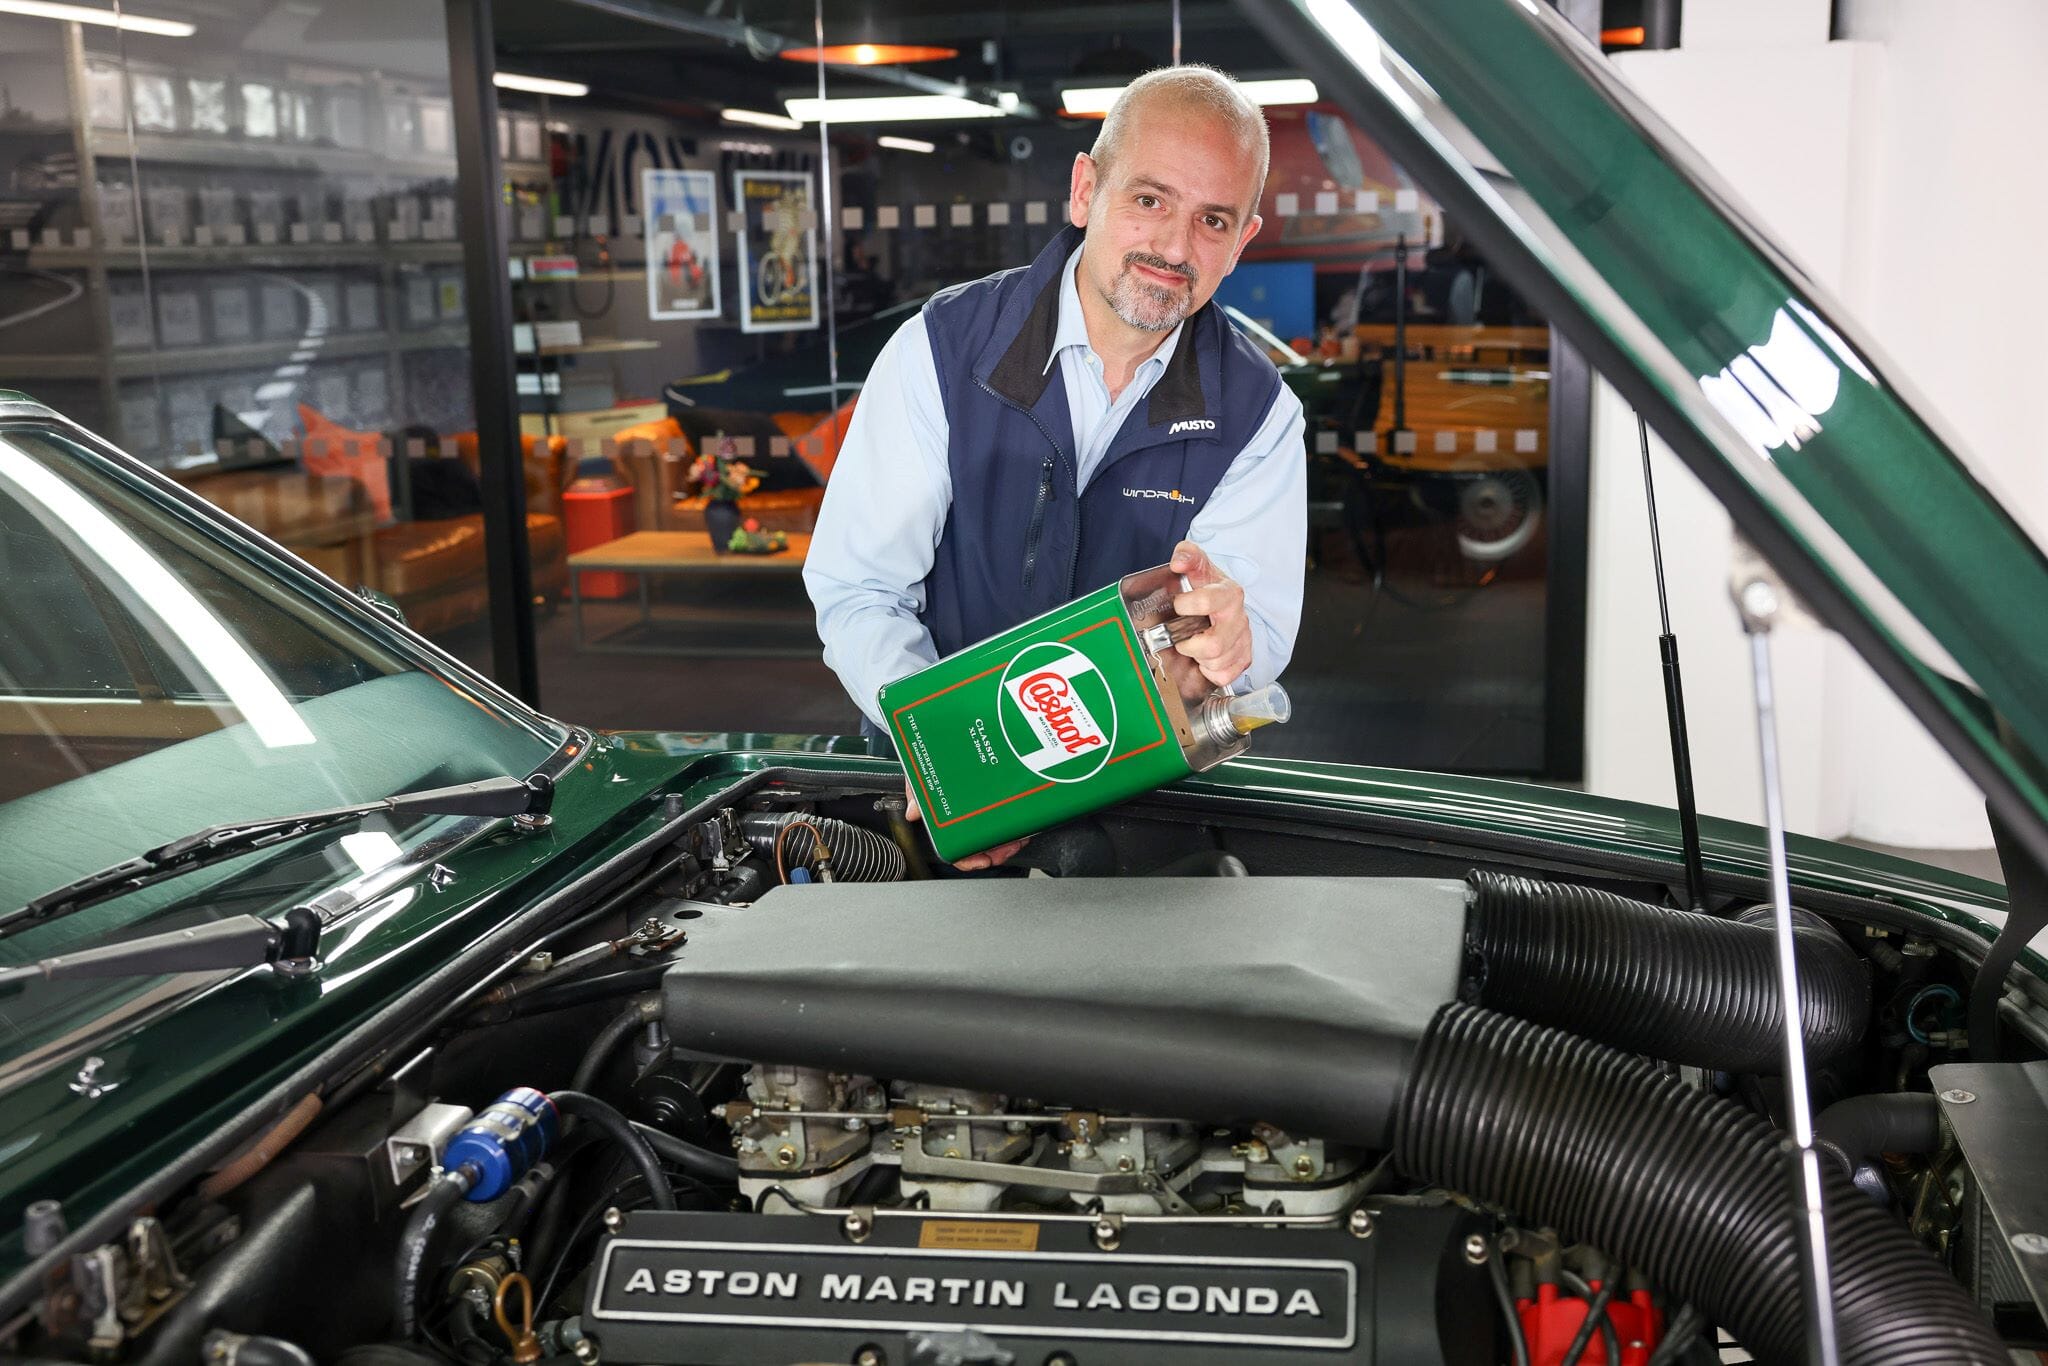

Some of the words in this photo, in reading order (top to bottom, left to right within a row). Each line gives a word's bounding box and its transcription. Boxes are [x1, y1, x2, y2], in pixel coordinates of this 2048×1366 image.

[1168, 420, 1215, 435] MUSTO
[1122, 487, 1195, 504] WINDRUH
[968, 726, 978, 739] XL
[1018, 672, 1101, 754] Castrol
[1038, 716, 1053, 737] MOTOR
[907, 713, 918, 731] THE
[914, 731, 940, 786] MASTERPIECE
[936, 785, 944, 797] IN
[940, 796, 952, 816] OILS
[975, 718, 999, 765] CLASSIC
[911, 740, 929, 775] Established
[925, 775, 935, 791] 1899
[624, 1268, 798, 1298] ASTON
[820, 1273, 1025, 1307] MARTIN
[1053, 1282, 1321, 1317] LAGONDA
